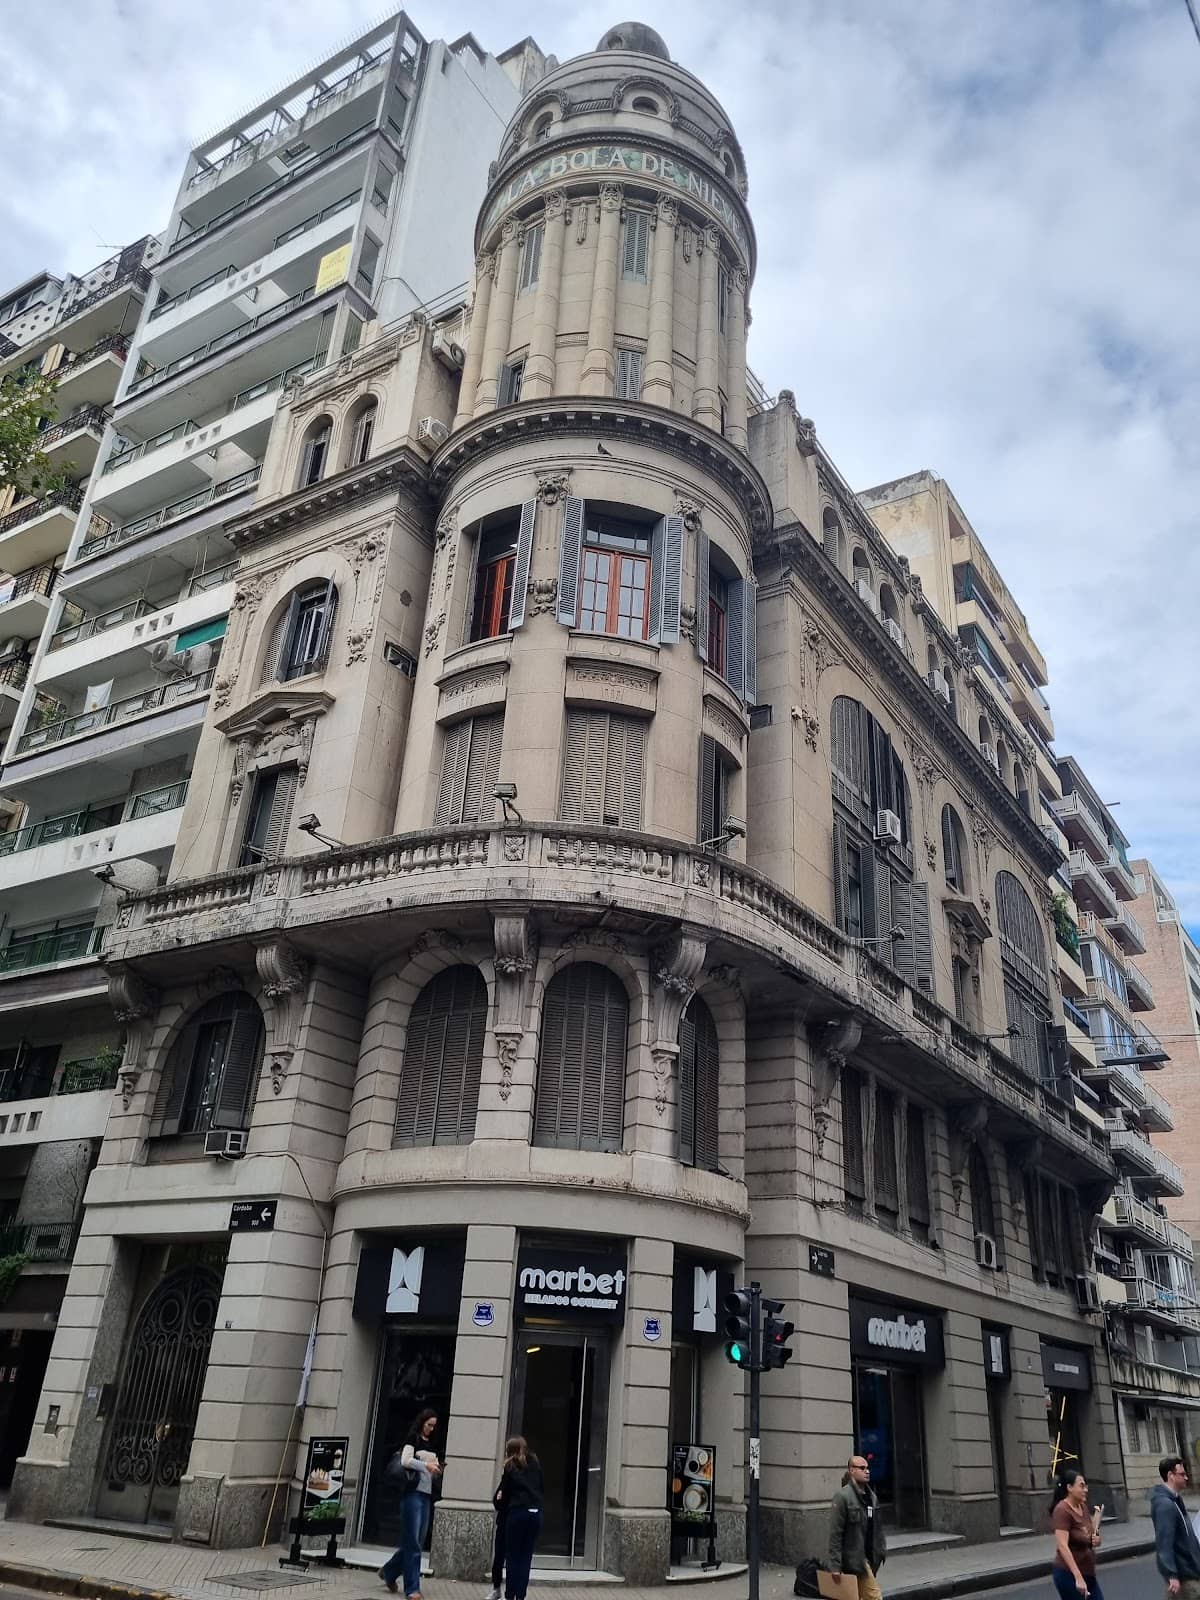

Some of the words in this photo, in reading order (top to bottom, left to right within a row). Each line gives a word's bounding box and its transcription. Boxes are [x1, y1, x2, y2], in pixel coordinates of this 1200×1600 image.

[508, 170, 537, 201] LA
[551, 147, 628, 175] BOLA
[641, 152, 674, 181] DE
[520, 1266, 626, 1295] marbet
[868, 1314, 926, 1353] marbet
